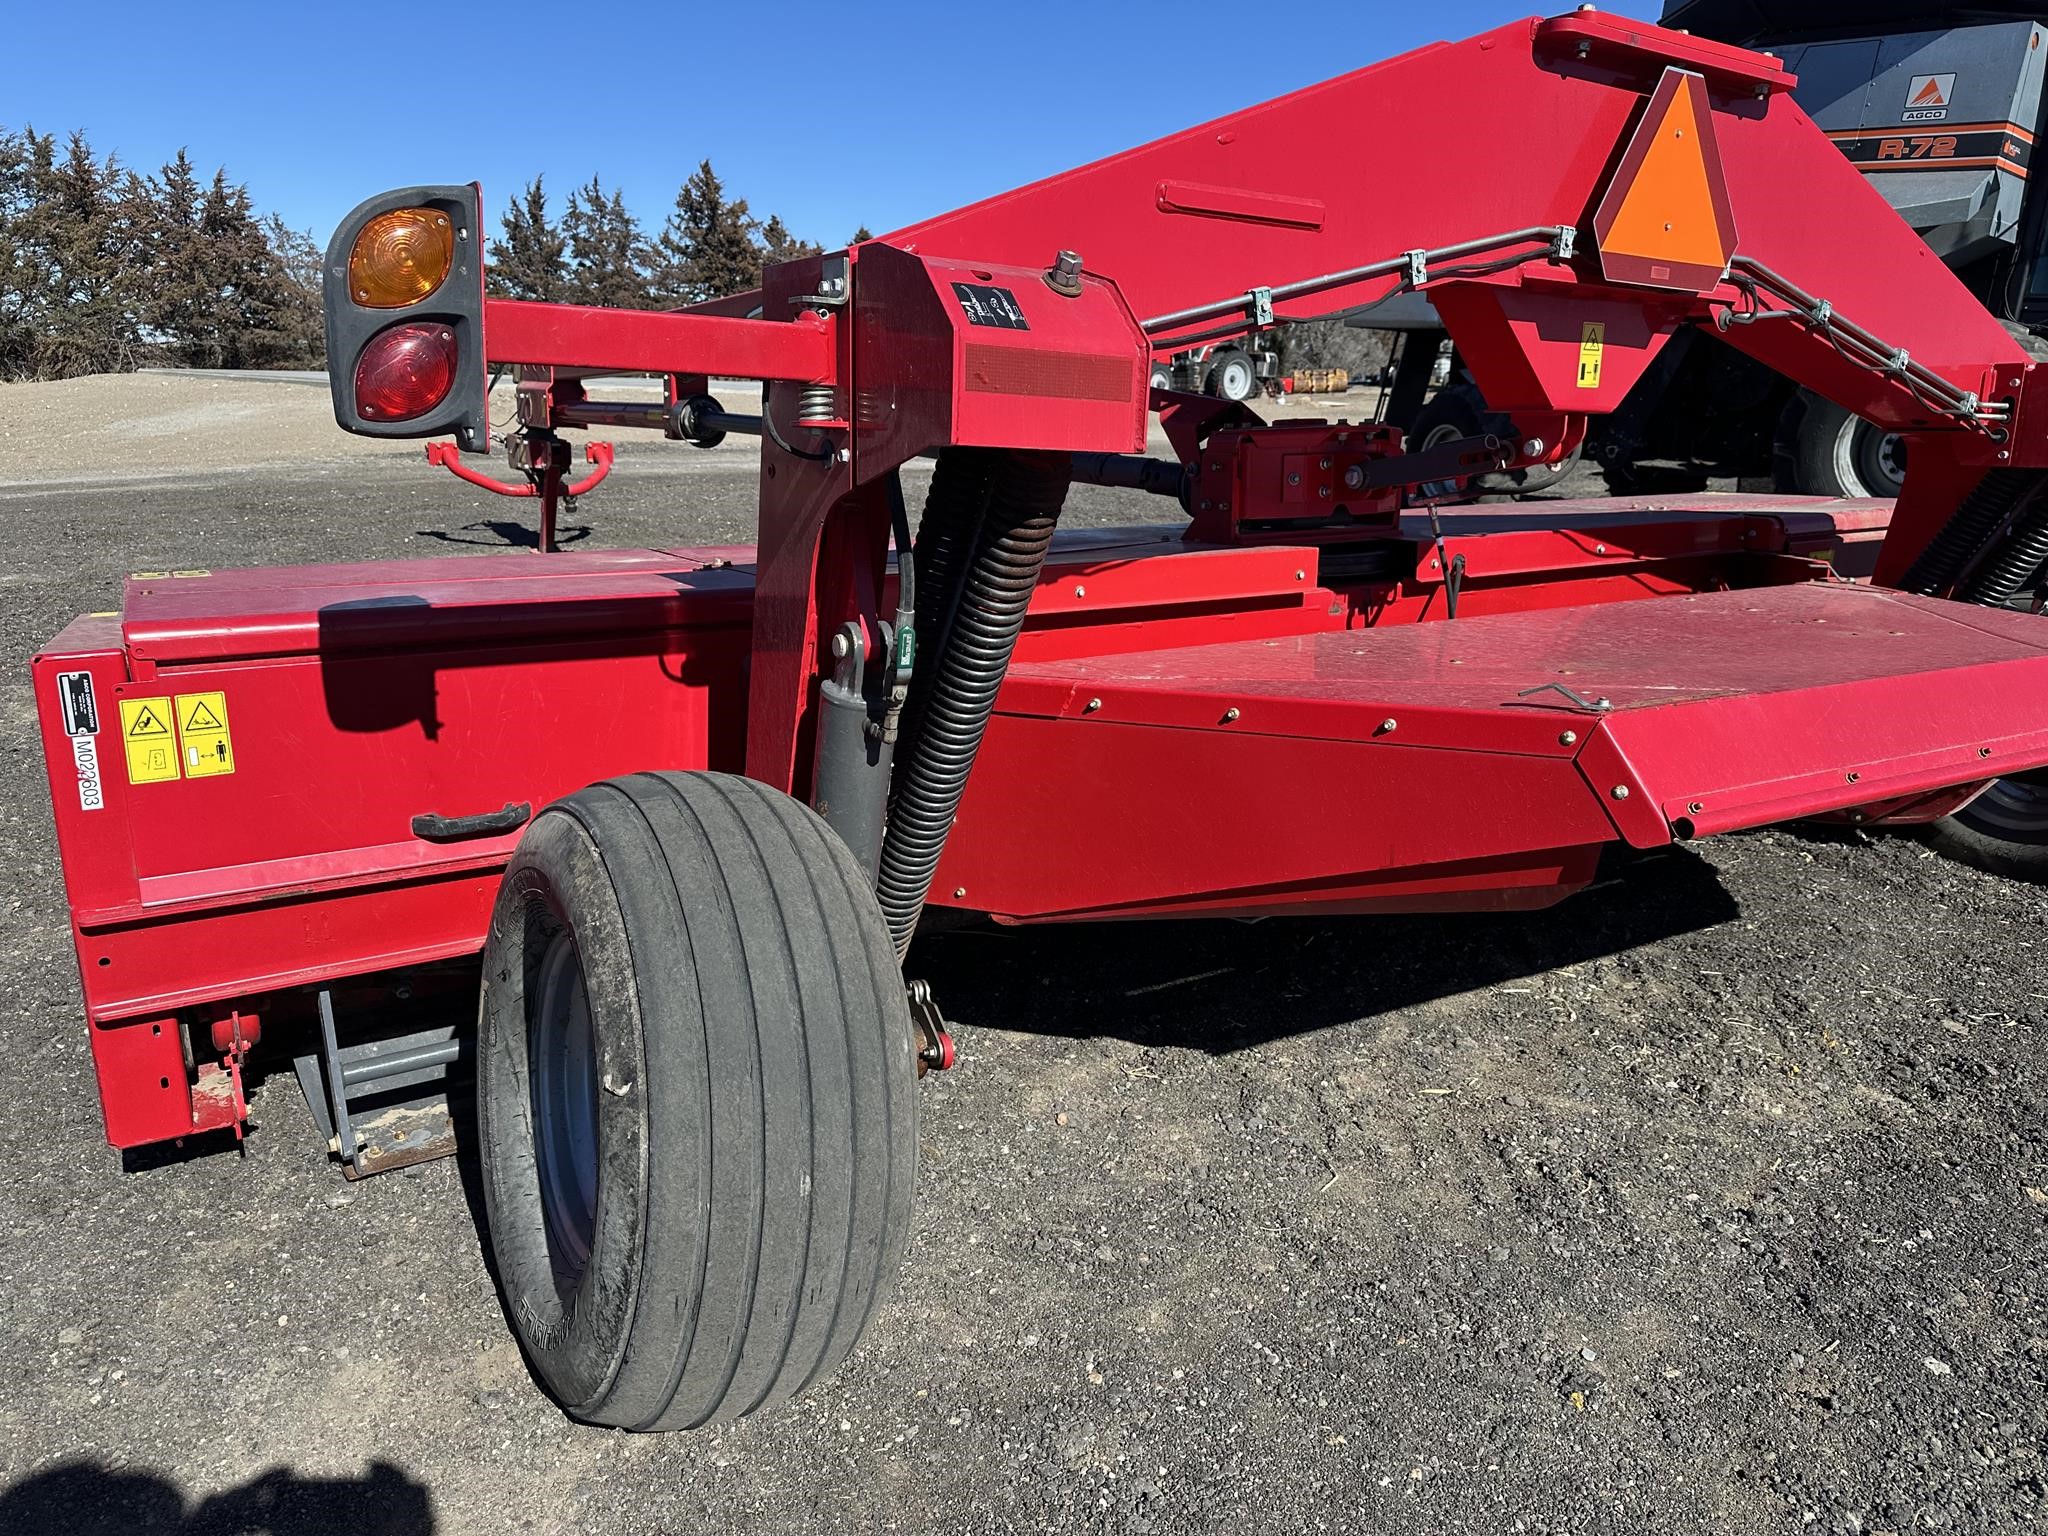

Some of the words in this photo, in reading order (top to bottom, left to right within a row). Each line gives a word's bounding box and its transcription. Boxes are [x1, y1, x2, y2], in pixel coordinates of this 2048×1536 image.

[1906, 111, 1942, 120] AGCO
[1877, 136, 1957, 159] R-72
[76, 740, 100, 806] M022603
